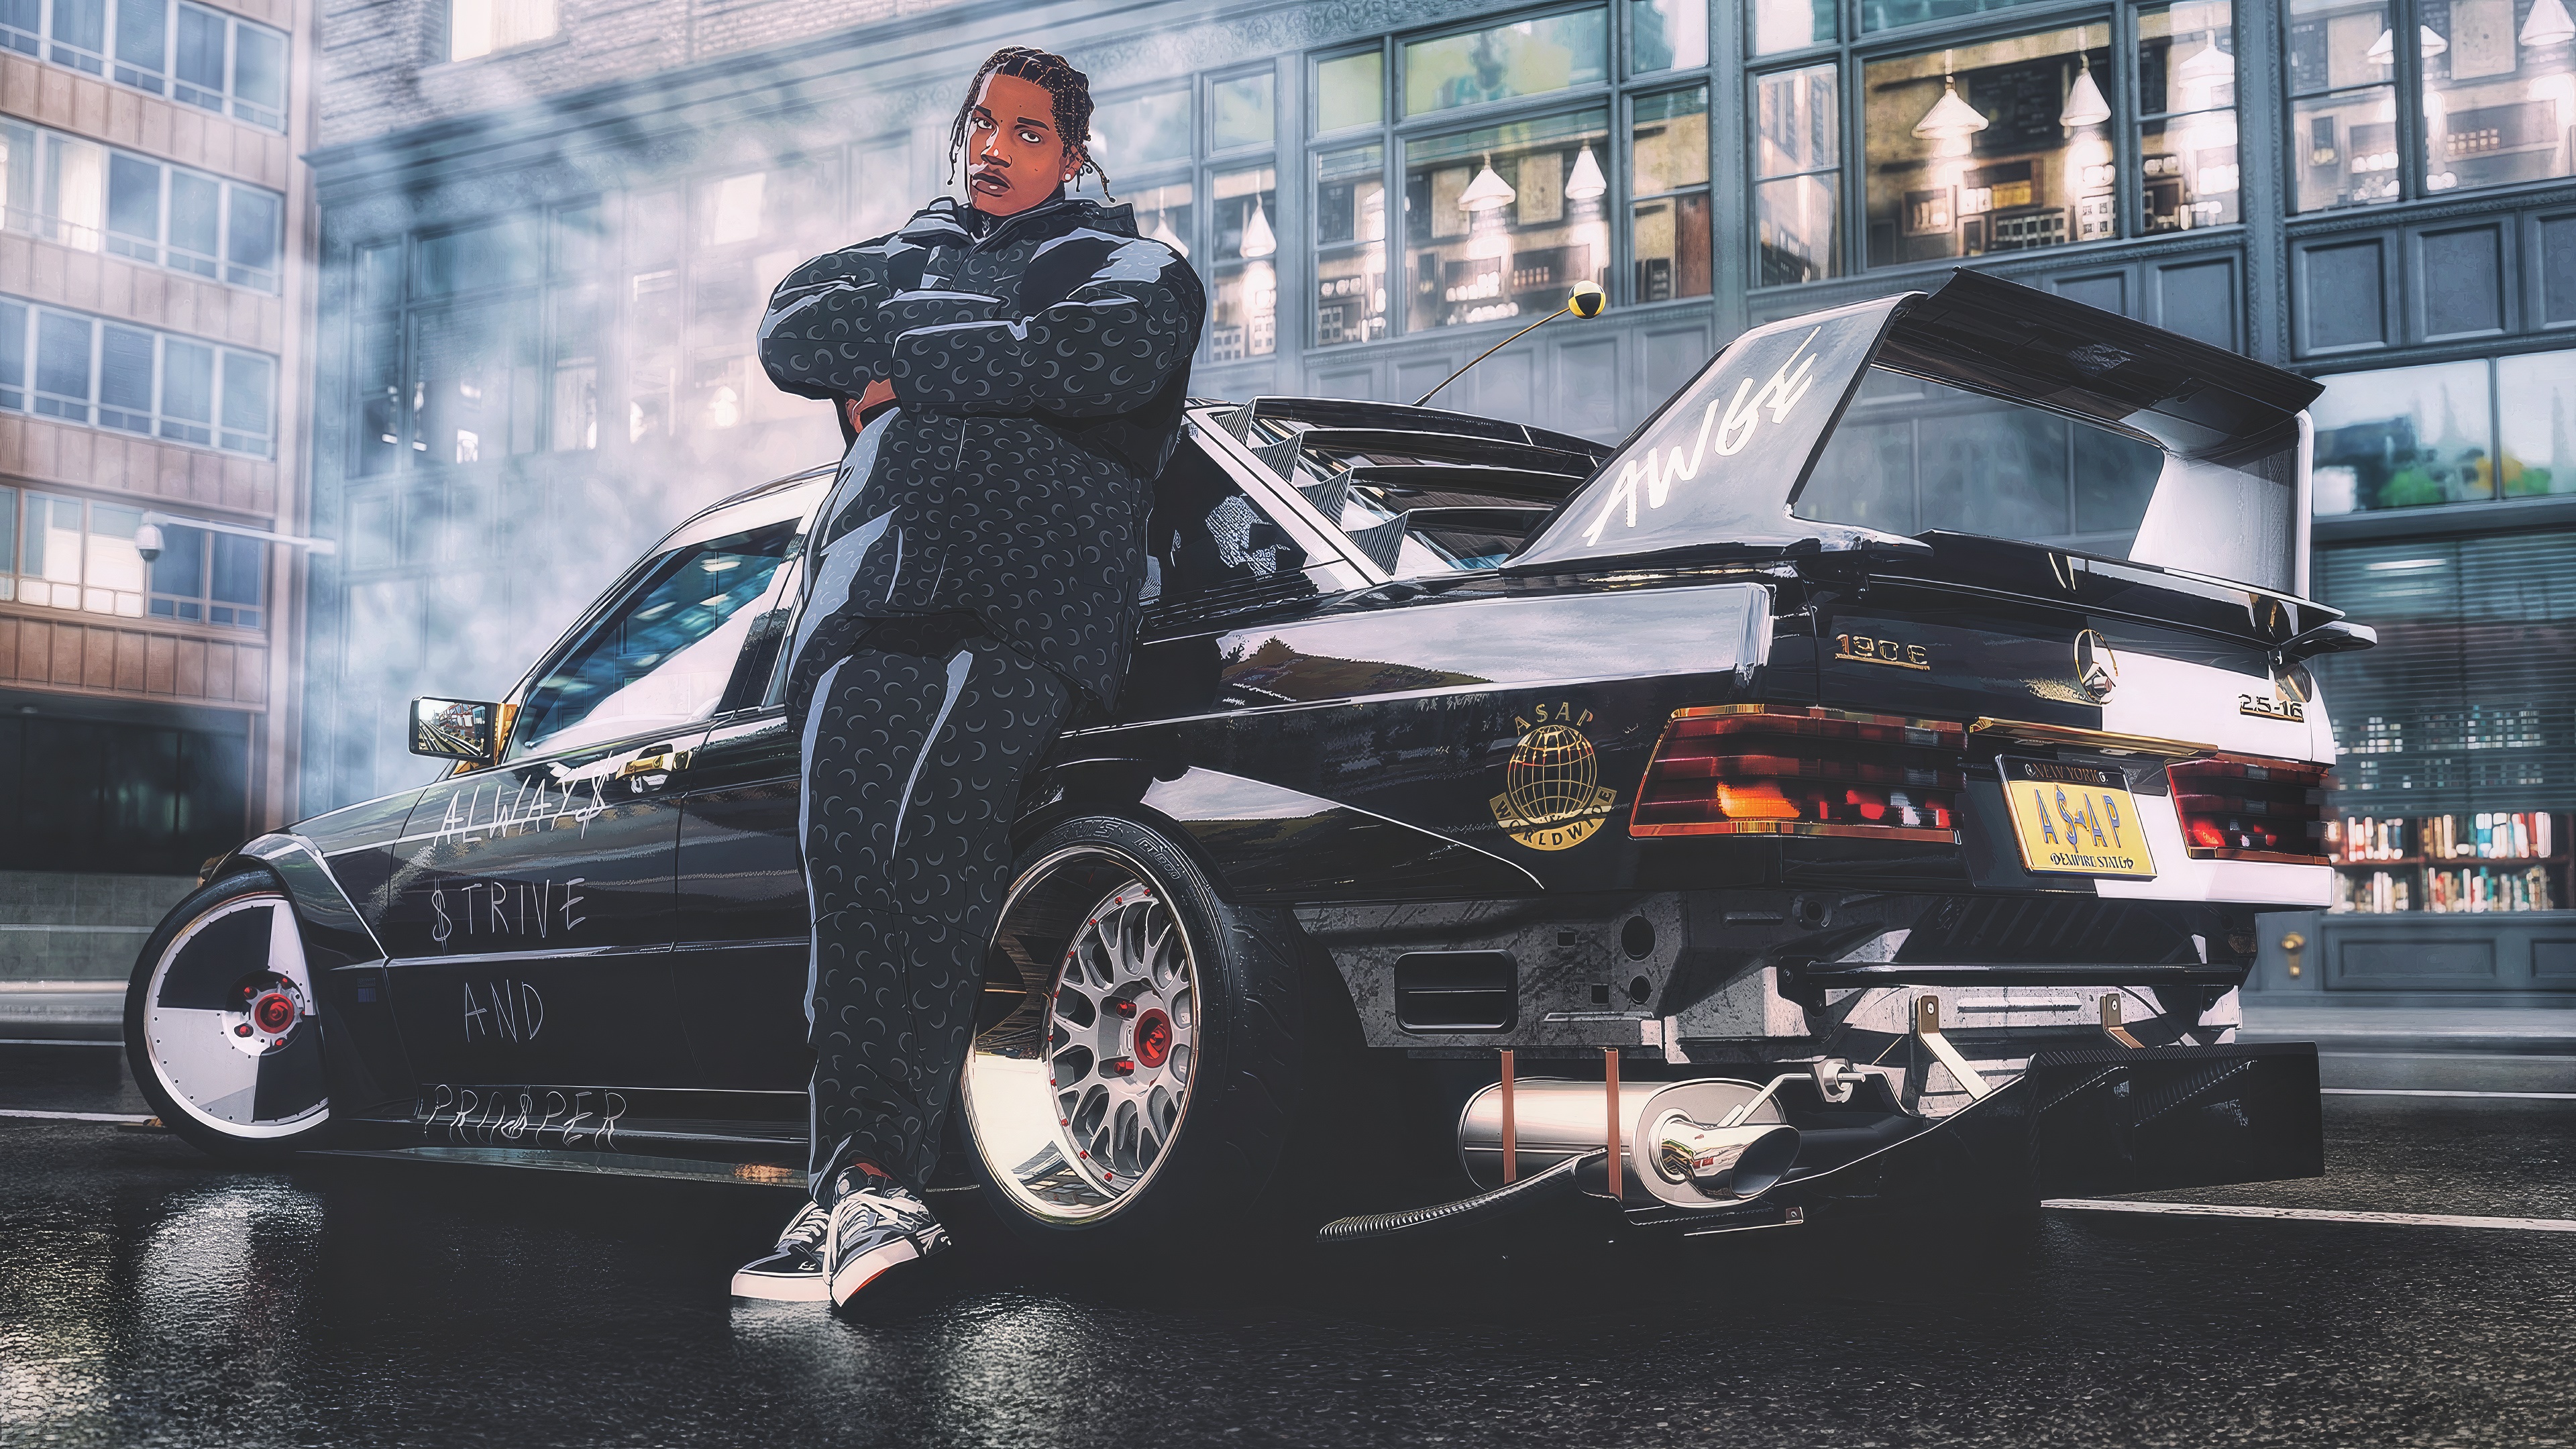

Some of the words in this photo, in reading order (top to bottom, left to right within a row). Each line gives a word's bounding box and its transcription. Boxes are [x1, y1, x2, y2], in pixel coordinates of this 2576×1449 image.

[2032, 763, 2064, 779] NEW
[2065, 765, 2100, 784] YORK
[464, 979, 544, 1042] AND
